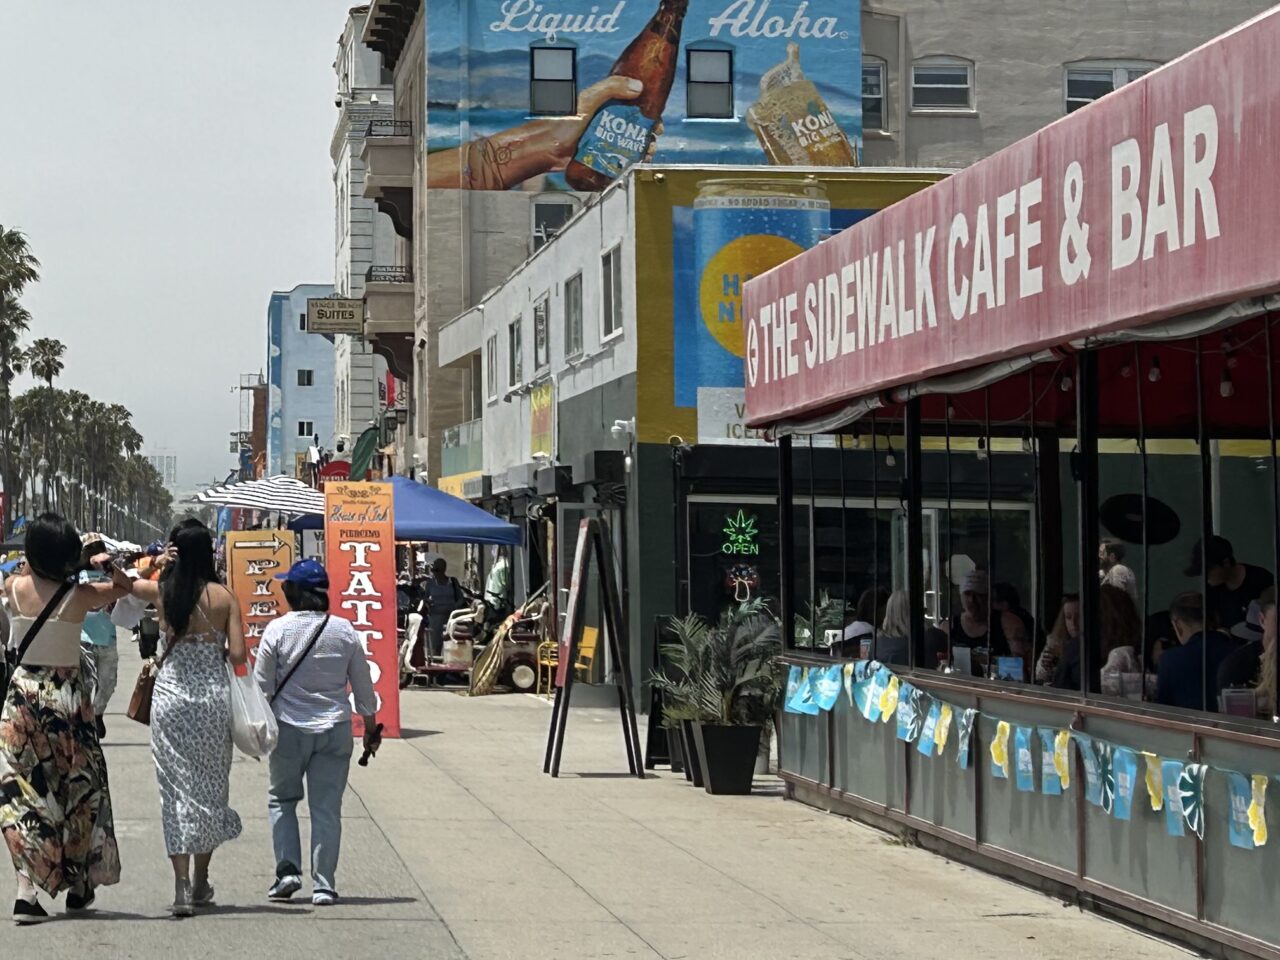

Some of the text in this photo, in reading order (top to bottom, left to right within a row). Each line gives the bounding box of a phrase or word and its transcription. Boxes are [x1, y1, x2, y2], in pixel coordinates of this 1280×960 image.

[595, 126, 616, 143] BIG
[600, 109, 647, 144] KONA
[760, 105, 1220, 384] THE SIDEWALK CAFE & BAR
[317, 309, 355, 319] SUITES
[722, 542, 759, 555] OPEN
